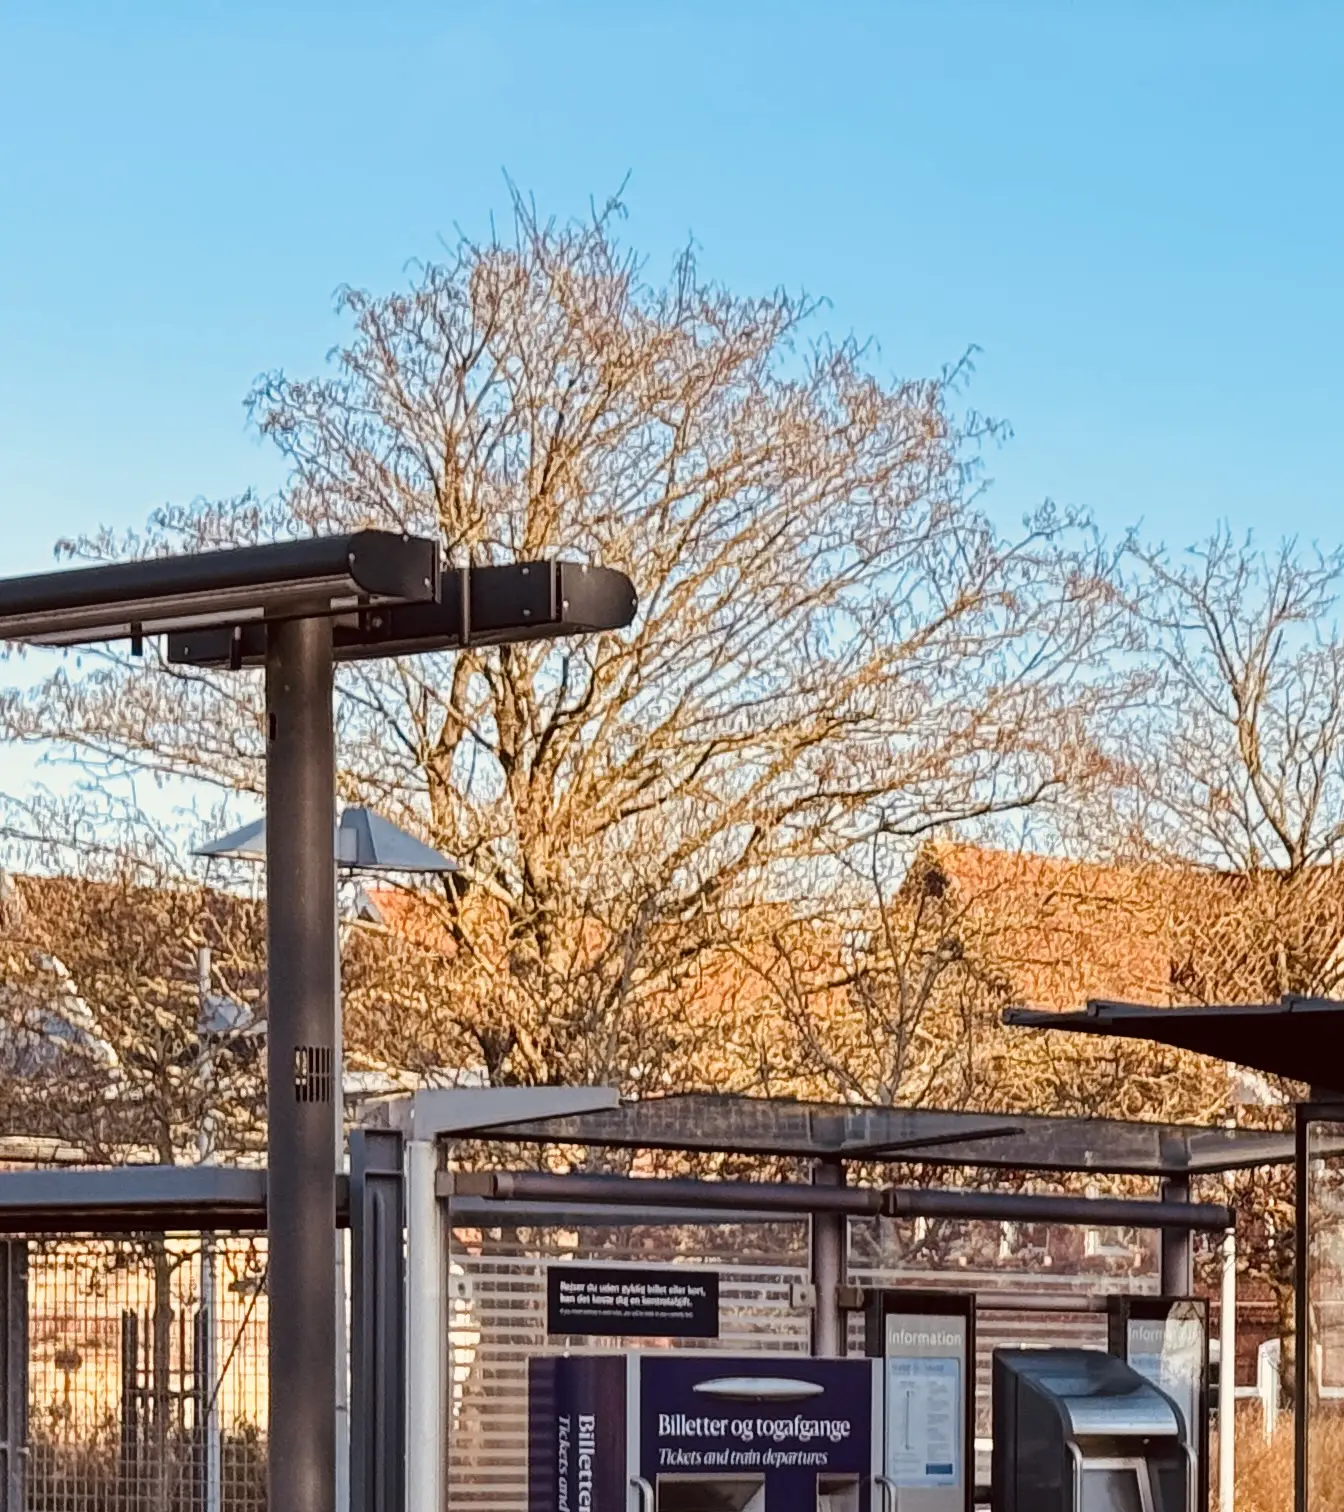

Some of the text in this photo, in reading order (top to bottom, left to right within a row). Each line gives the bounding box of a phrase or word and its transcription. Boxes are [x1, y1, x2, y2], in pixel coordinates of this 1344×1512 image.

[889, 1329, 962, 1347] Information
[659, 1413, 850, 1442] Billetter og togafgange
[558, 1415, 571, 1475] Tickets
[659, 1448, 829, 1468] Tickets and train departures
